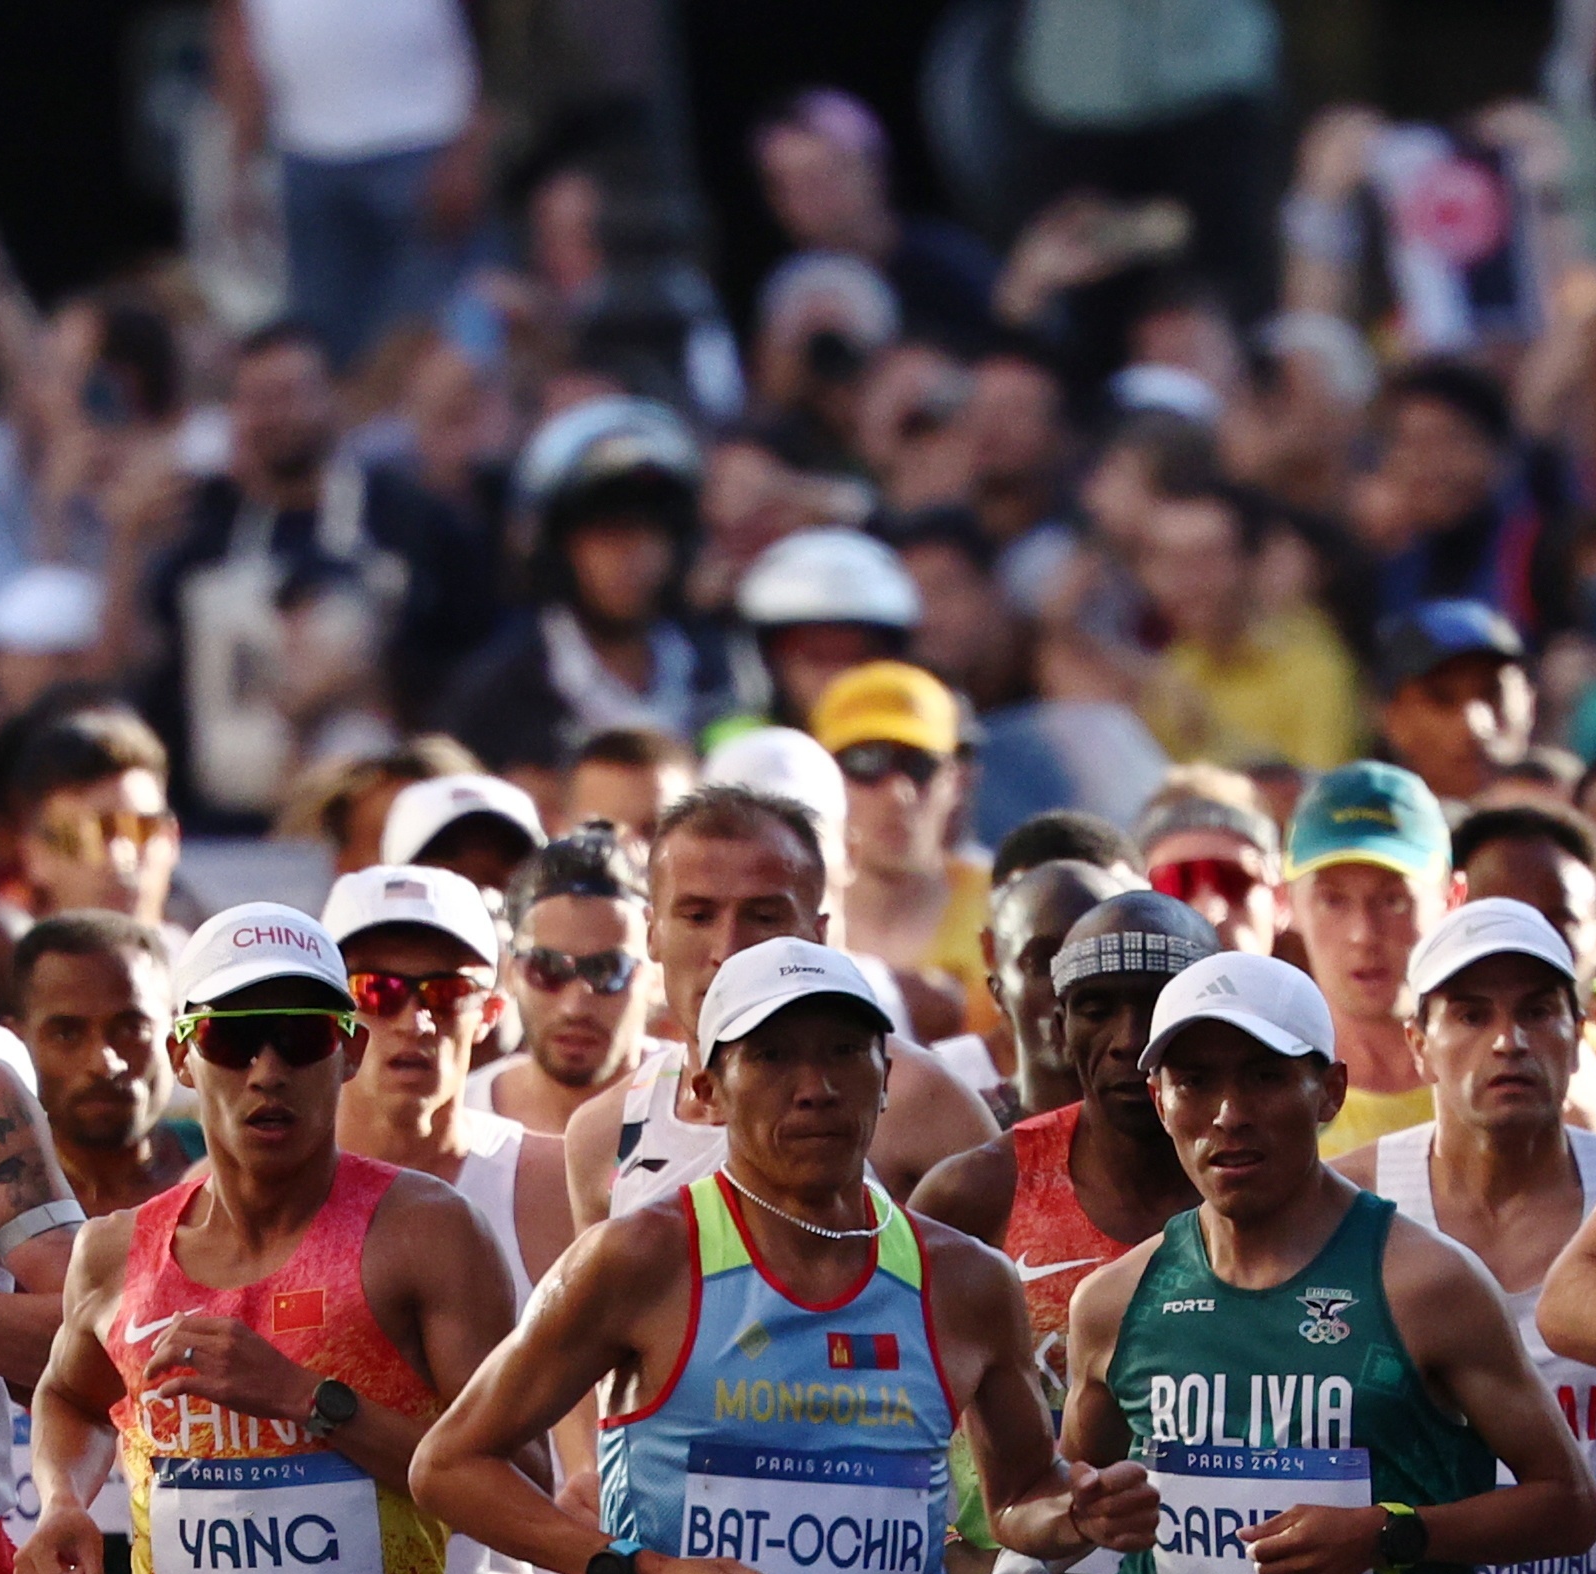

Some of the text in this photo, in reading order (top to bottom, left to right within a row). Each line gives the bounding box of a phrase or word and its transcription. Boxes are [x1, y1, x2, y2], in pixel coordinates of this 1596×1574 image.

[232, 926, 322, 960] CHINA
[1162, 1298, 1216, 1315] FORTE
[714, 1378, 916, 1428] MONGOLIA
[1150, 1372, 1353, 1450] BOLIVIA
[191, 1464, 305, 1482] PARIS 2024
[755, 1455, 875, 1478] PARIS 2024
[1187, 1453, 1305, 1472] PARIS 2024
[179, 1513, 339, 1569] YANG
[687, 1504, 924, 1572] BAT-OCHIR
